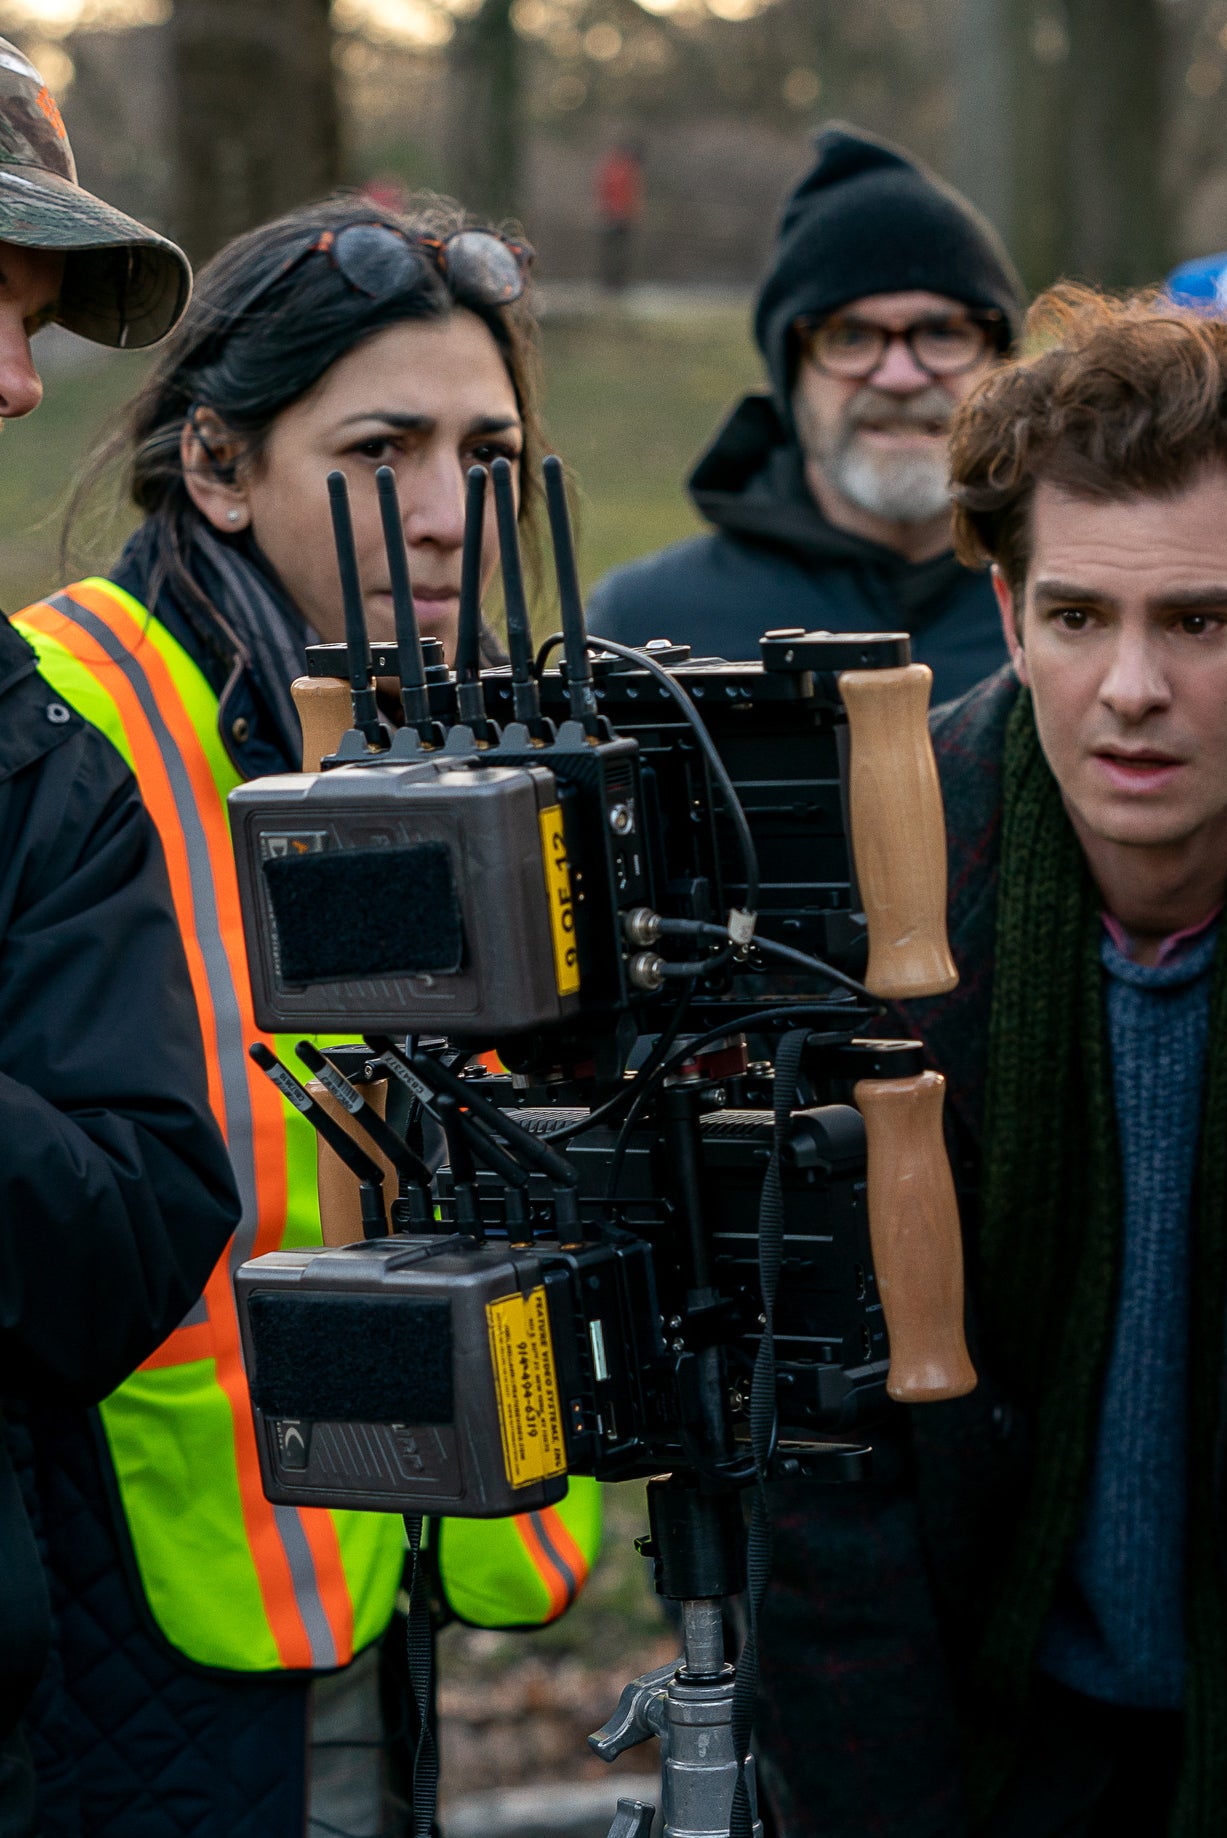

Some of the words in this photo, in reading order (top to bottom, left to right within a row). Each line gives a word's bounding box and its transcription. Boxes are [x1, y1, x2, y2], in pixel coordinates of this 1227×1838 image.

[552, 832, 568, 872] 12
[558, 888, 575, 933] OF
[565, 948, 577, 968] 9
[535, 1296, 547, 1347] FEATURE
[541, 1350, 552, 1387] VIDEO
[516, 1341, 538, 1438] 914-494-6319
